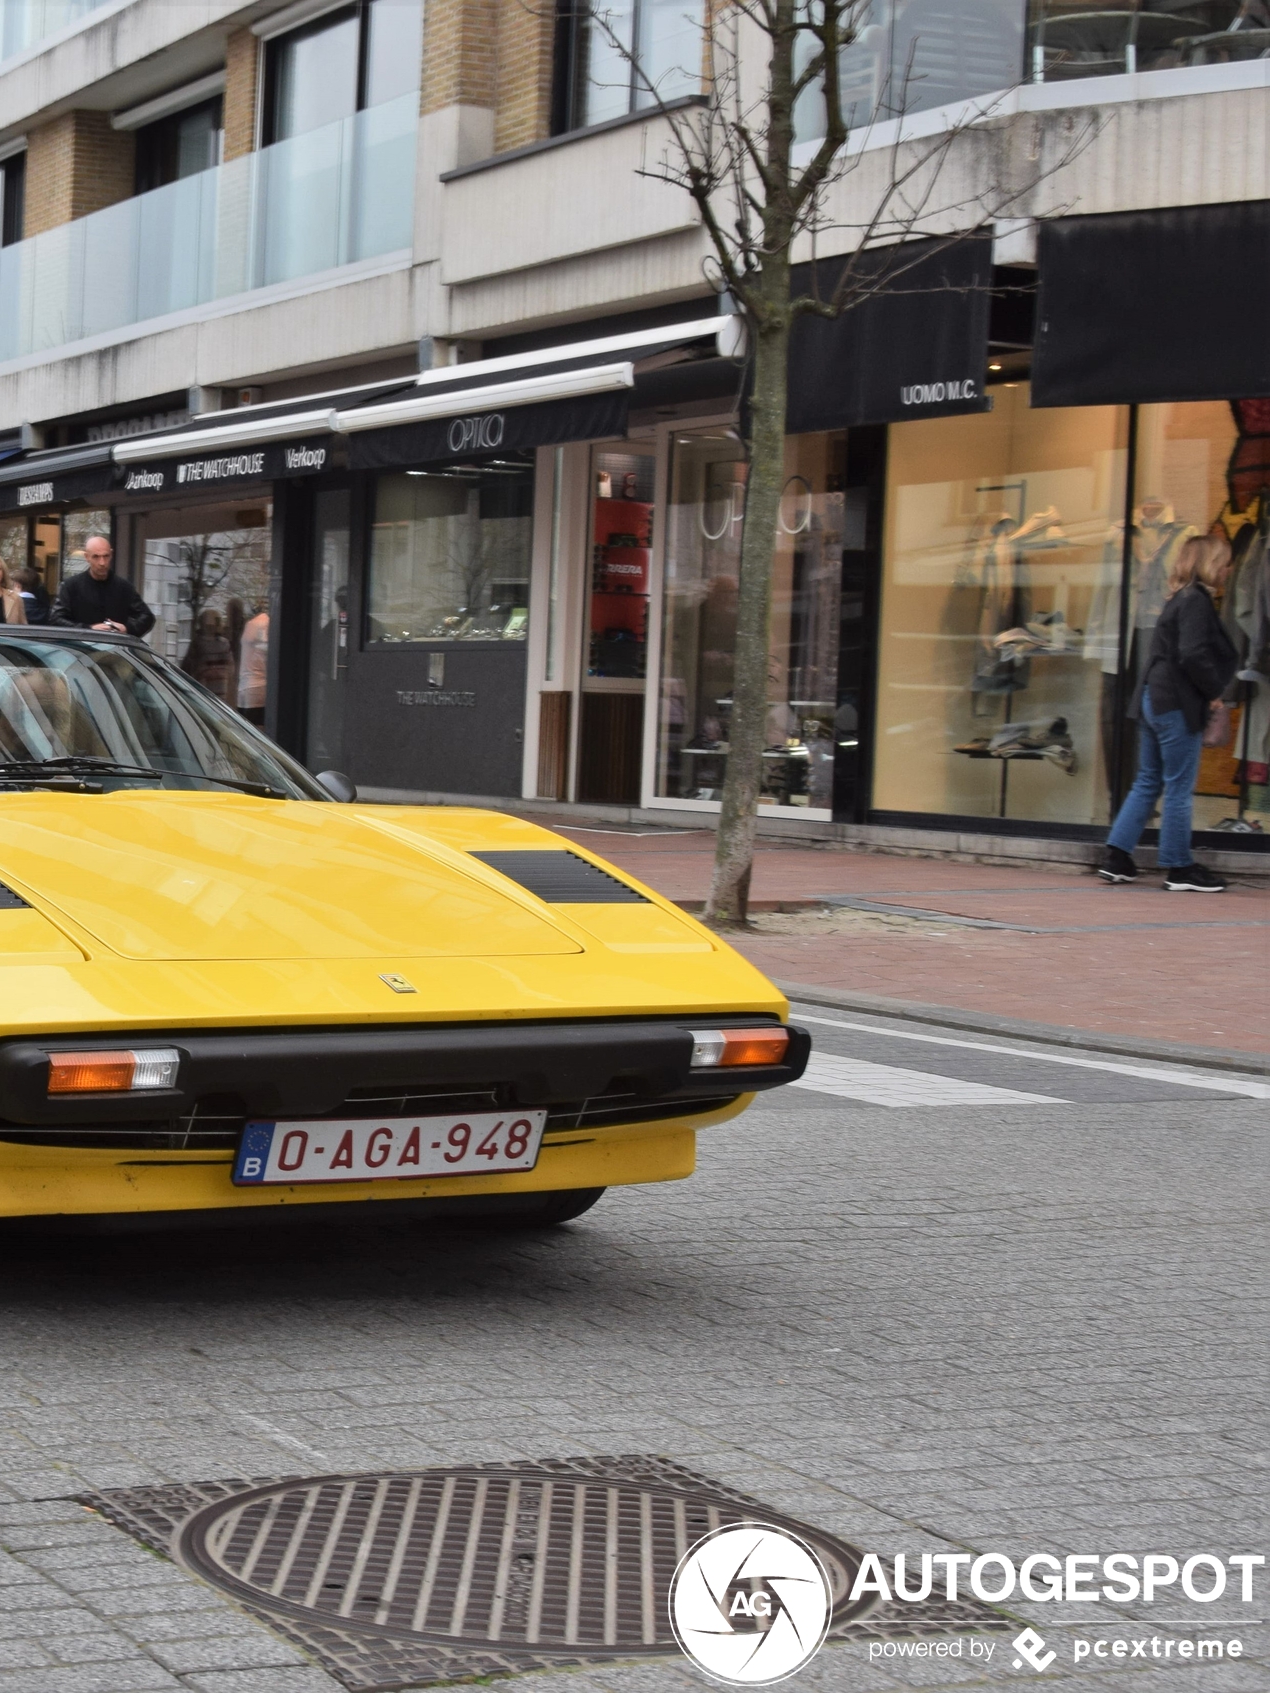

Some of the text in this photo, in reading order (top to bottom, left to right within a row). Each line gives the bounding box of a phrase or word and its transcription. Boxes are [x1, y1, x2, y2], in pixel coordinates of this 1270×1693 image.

[900, 382, 945, 405] UOMO
[124, 445, 326, 491] Aankoop THE WATCHHOUSE Verkoop
[607, 563, 643, 575] RRERA
[277, 1118, 532, 1171] O-AGA-948
[242, 1157, 262, 1177] B
